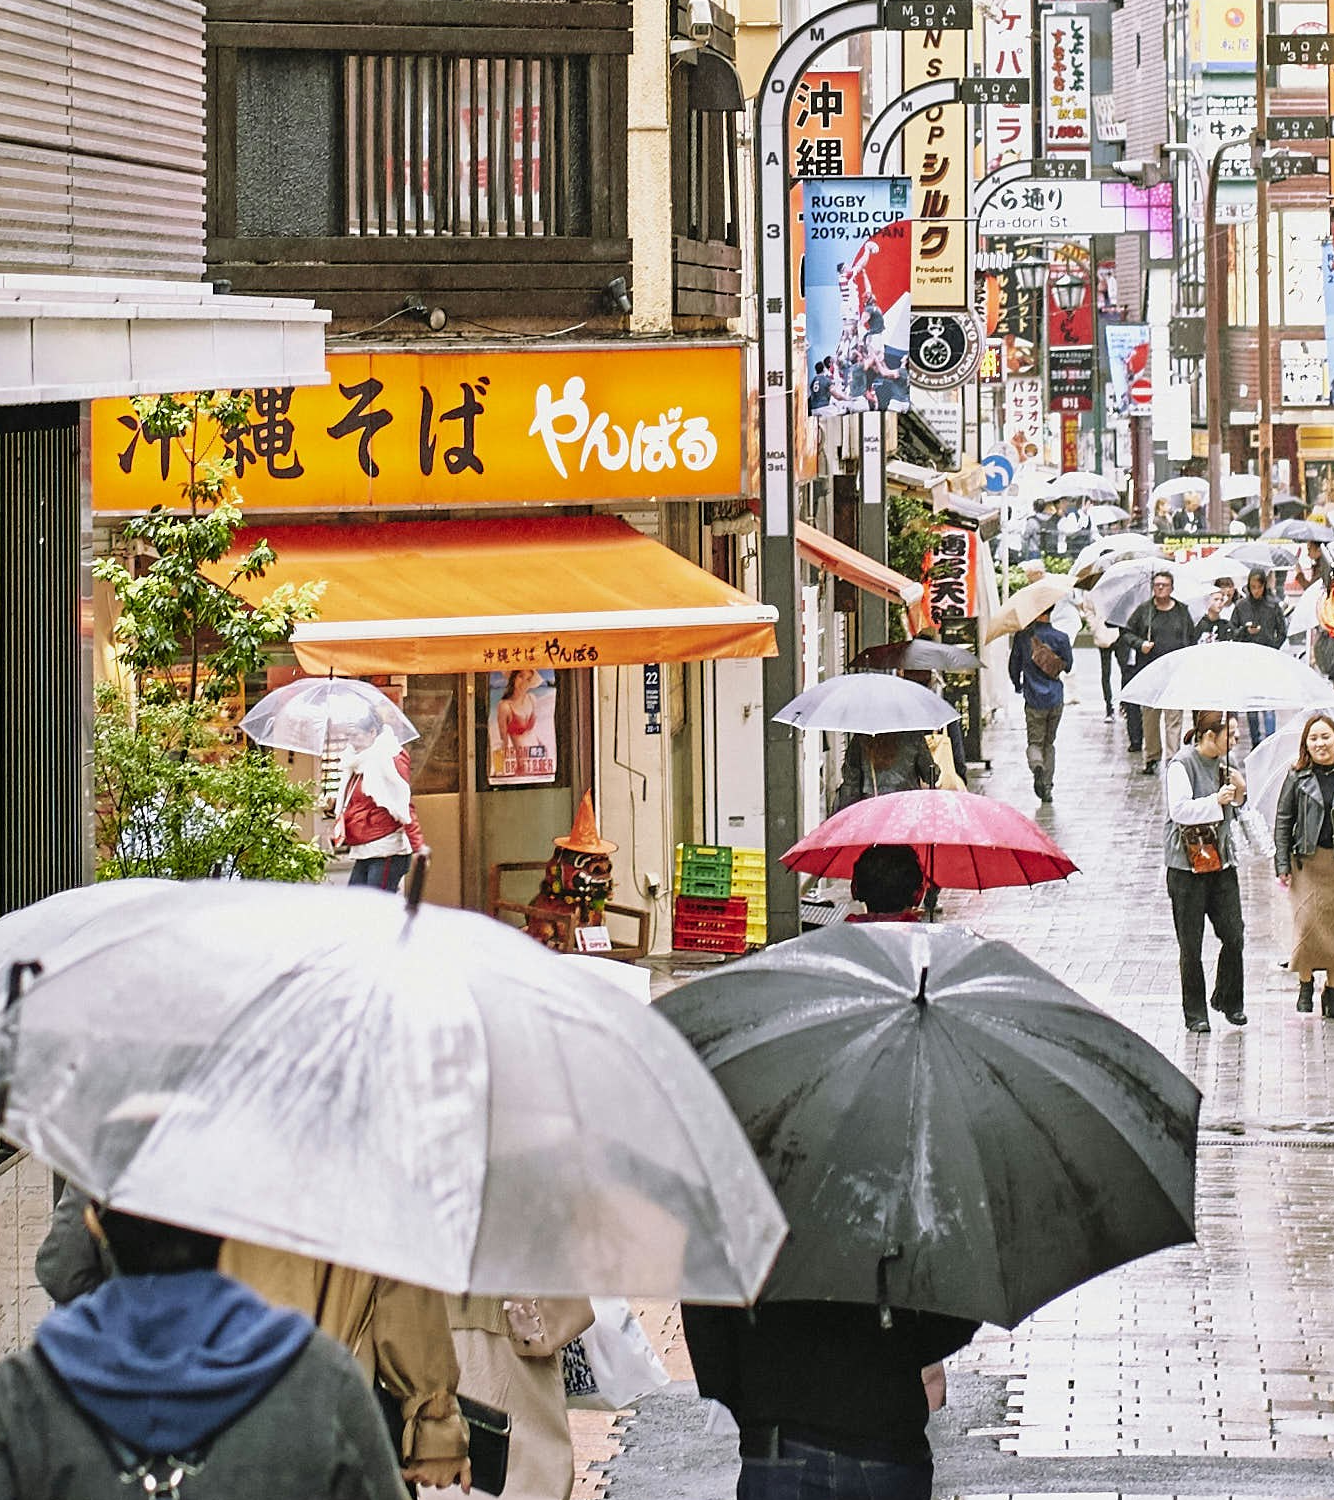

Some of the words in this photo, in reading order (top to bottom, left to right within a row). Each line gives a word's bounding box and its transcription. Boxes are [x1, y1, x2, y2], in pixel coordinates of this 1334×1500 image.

[902, 5, 957, 16] MOA
[910, 16, 955, 27] 3st.
[1280, 42, 1330, 52] MOA
[973, 84, 1017, 93] MOA
[1276, 122, 1315, 131] MOA
[811, 196, 866, 209] RUGBY
[919, 153, 950, 260] シルク
[811, 211, 869, 223] WORLD
[872, 211, 905, 223] CUP
[811, 227, 850, 241] 2019,
[852, 226, 905, 240] JAPAN
[915, 265, 955, 273] Produced
[1012, 381, 1024, 423] パセラ
[1027, 381, 1039, 437] カラオケ
[529, 375, 719, 481] やんばる
[484, 647, 536, 664] 沖縄そば
[544, 637, 599, 666] やんばる
[646, 671, 659, 685] 22
